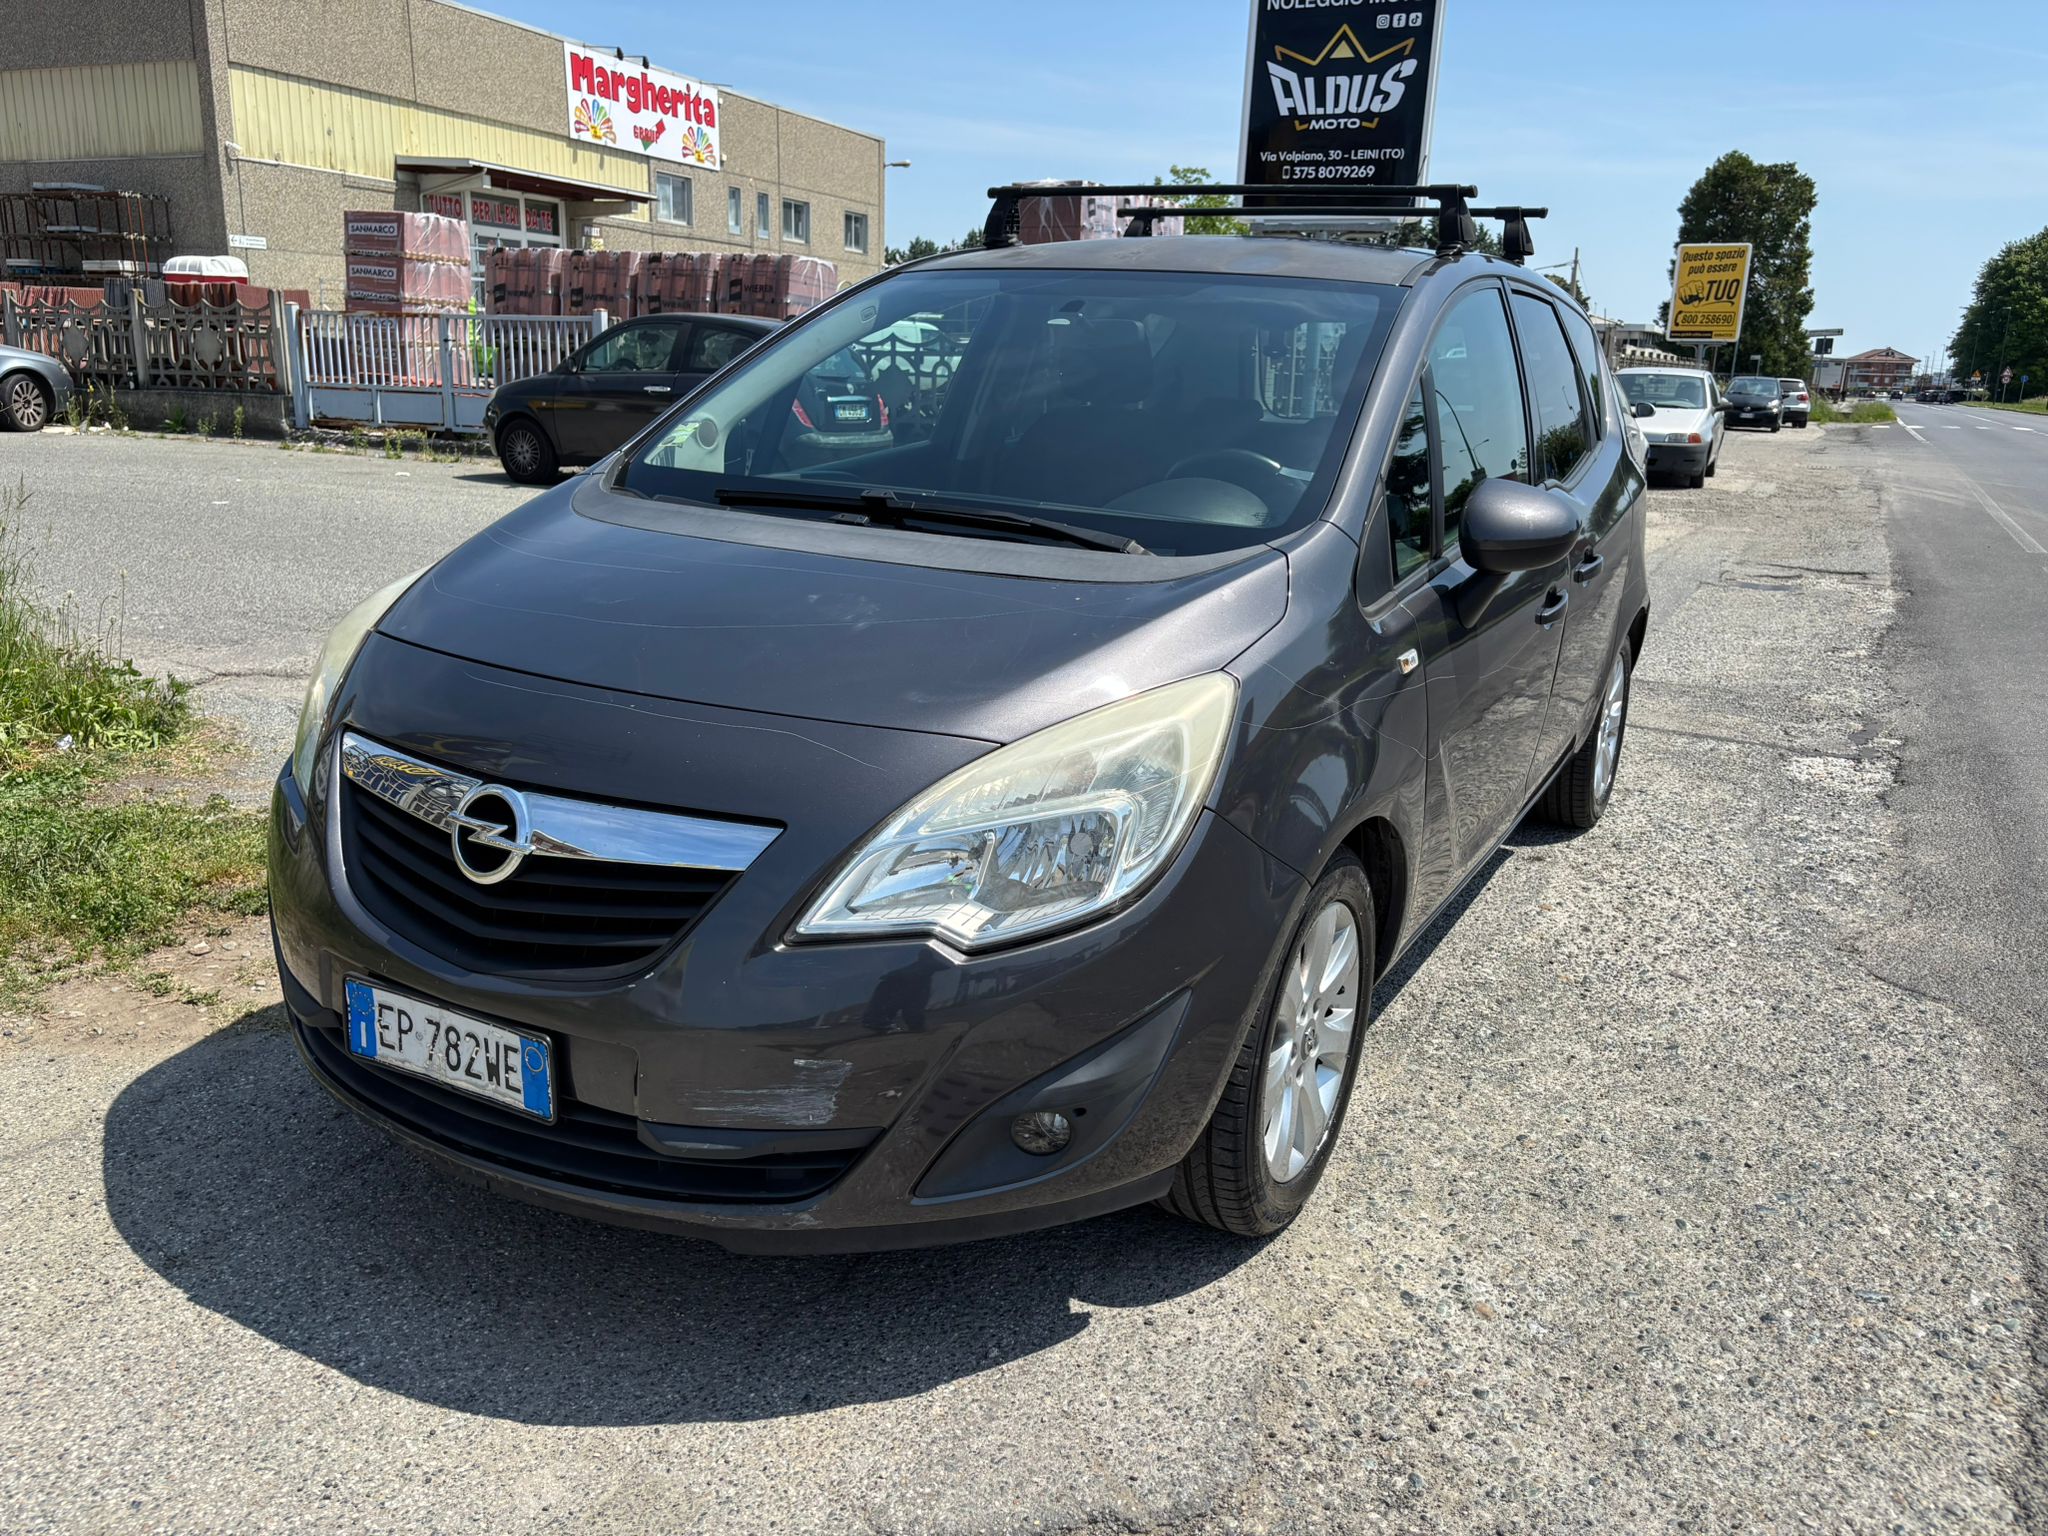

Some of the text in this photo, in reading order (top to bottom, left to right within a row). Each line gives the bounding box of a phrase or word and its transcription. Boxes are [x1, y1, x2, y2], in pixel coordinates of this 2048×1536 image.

[570, 52, 716, 129] Margherita
[1266, 58, 1418, 116] ALDUS
[1309, 118, 1361, 130] MOTO
[1260, 151, 1277, 162] Via
[1278, 151, 1326, 163] Volpiano,
[1328, 150, 1342, 161] 30
[1351, 149, 1379, 160] LEINI
[1380, 148, 1405, 160] (TO)
[1292, 165, 1376, 179] 375 8079269
[428, 194, 462, 217] TUTTO
[472, 201, 491, 222] PER
[494, 204, 503, 224] IL
[526, 207, 539, 228] DA
[541, 210, 553, 232] TE
[351, 223, 396, 234] SANMARCO
[1682, 248, 1746, 263] Questo spazio
[351, 267, 395, 278] SANMARCO
[1706, 263, 1738, 273] essere
[1704, 279, 1740, 301] TUO
[1681, 314, 1698, 325] 800
[378, 1003, 522, 1094] EP 782WE
